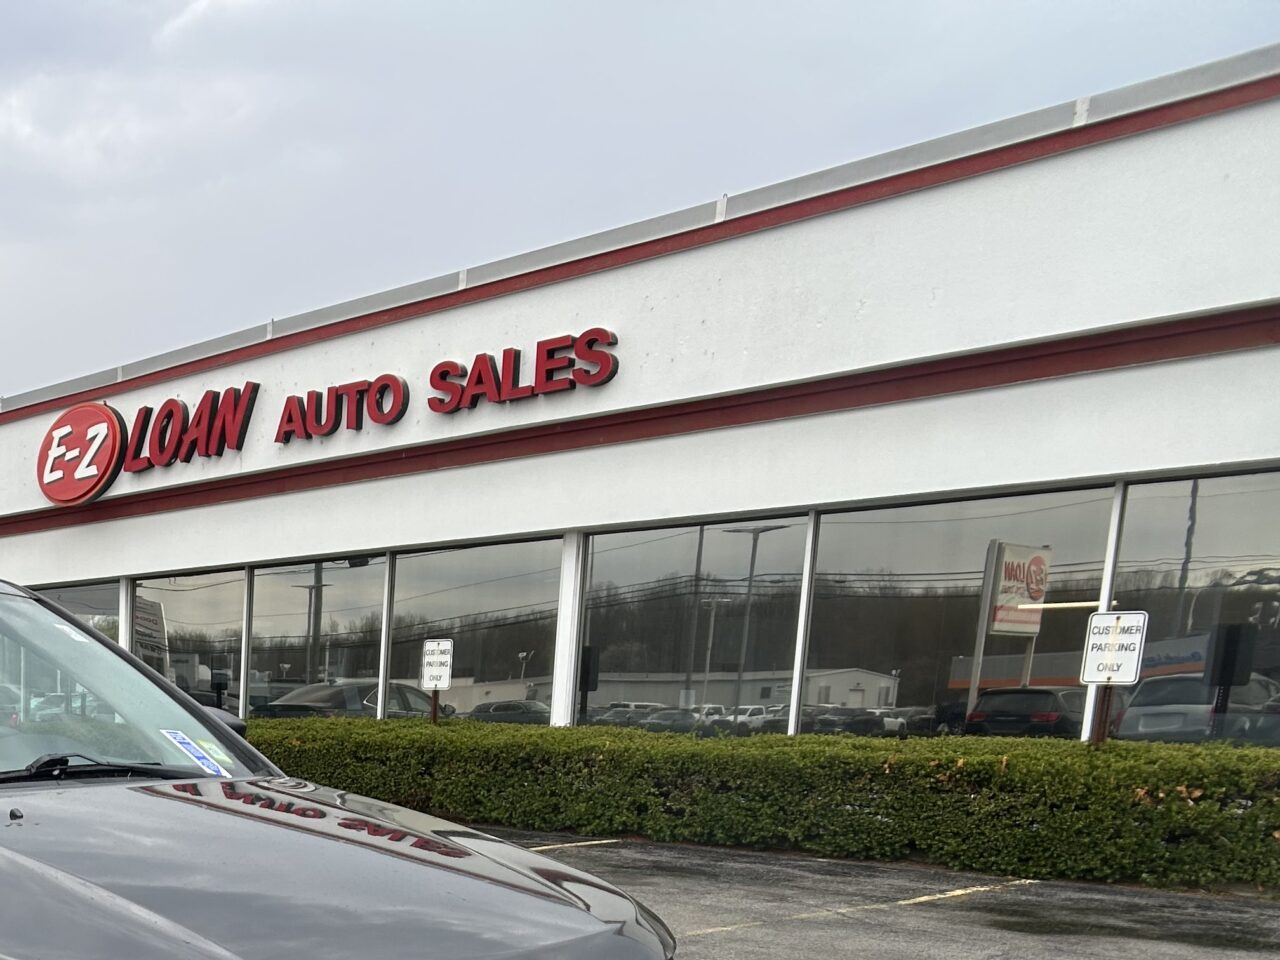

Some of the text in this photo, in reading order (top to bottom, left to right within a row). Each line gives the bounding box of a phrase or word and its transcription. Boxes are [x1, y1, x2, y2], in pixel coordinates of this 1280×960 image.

[43, 328, 619, 484] E-Z LOAN AUTO SALES
[1091, 625, 1142, 635] CUSTOMER
[1090, 642, 1136, 652] PARKING
[1096, 662, 1123, 672] ONLY
